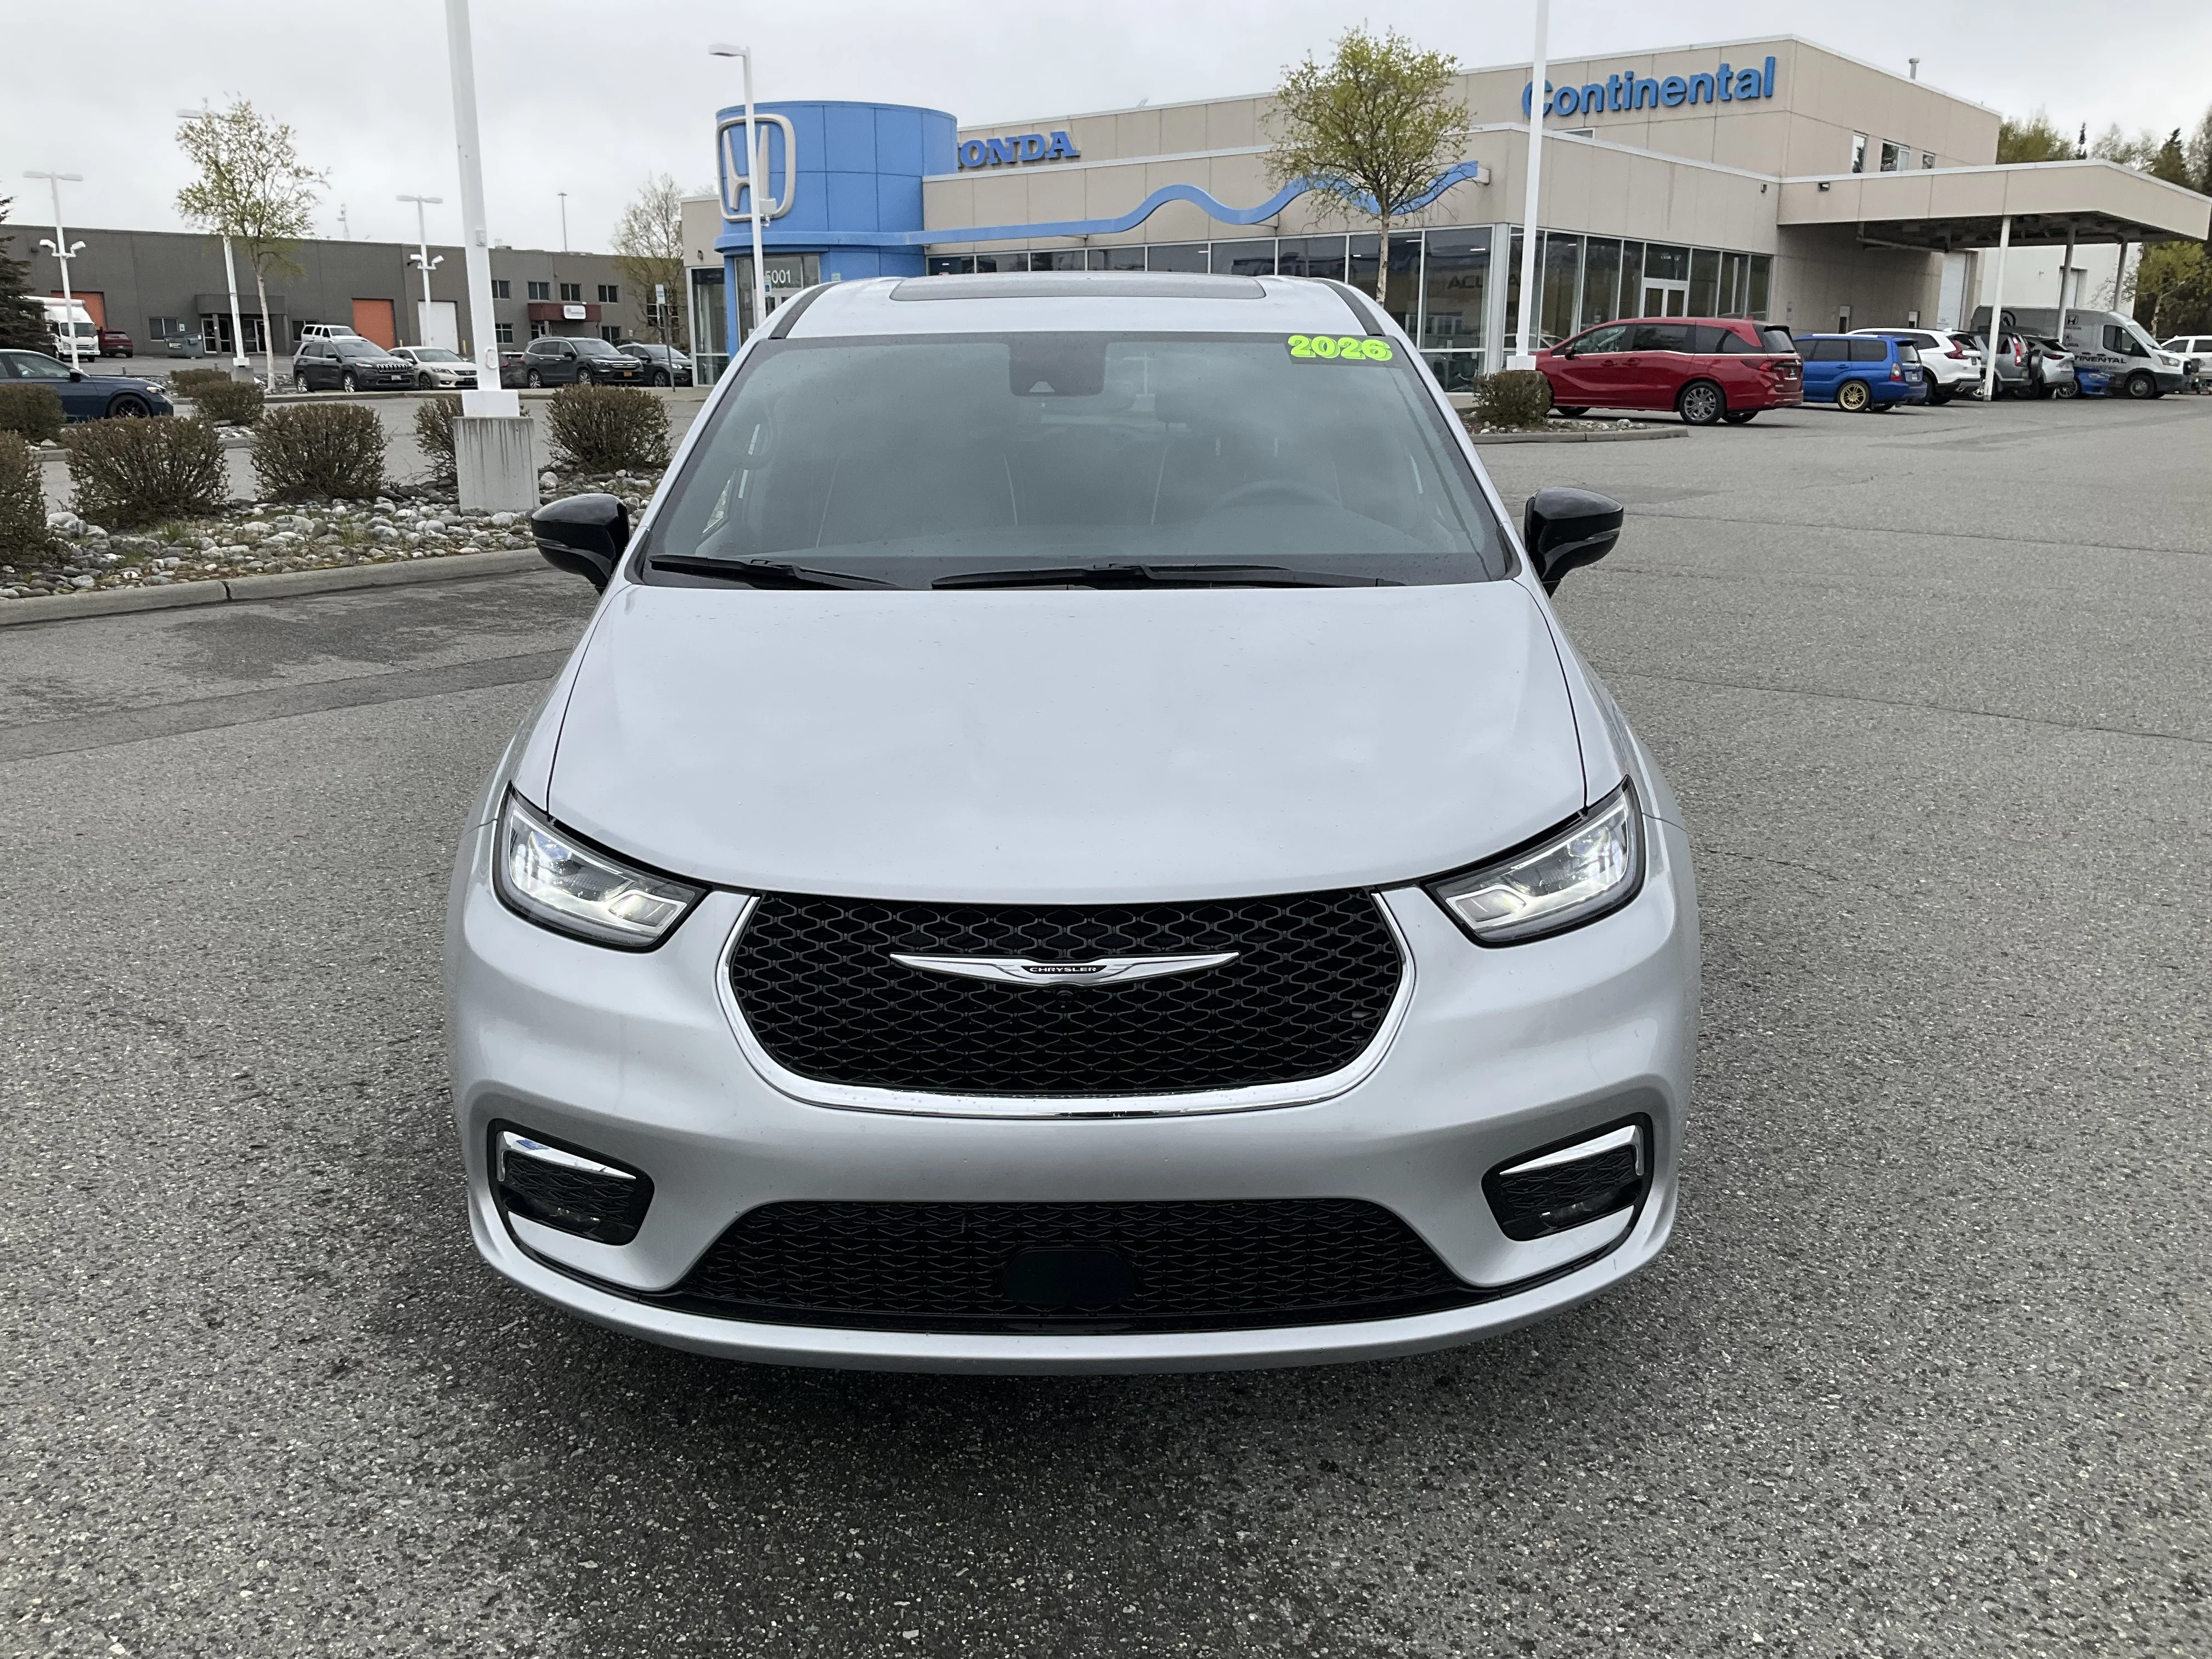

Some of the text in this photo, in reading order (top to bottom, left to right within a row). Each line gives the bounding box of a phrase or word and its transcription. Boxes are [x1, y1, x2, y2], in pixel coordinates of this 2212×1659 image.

[1522, 56, 1775, 117] Continental
[957, 131, 1081, 167] ONDA
[1447, 274, 1521, 289] ACA
[1288, 335, 1392, 362] 2026
[2074, 355, 2127, 364] TINENTAL
